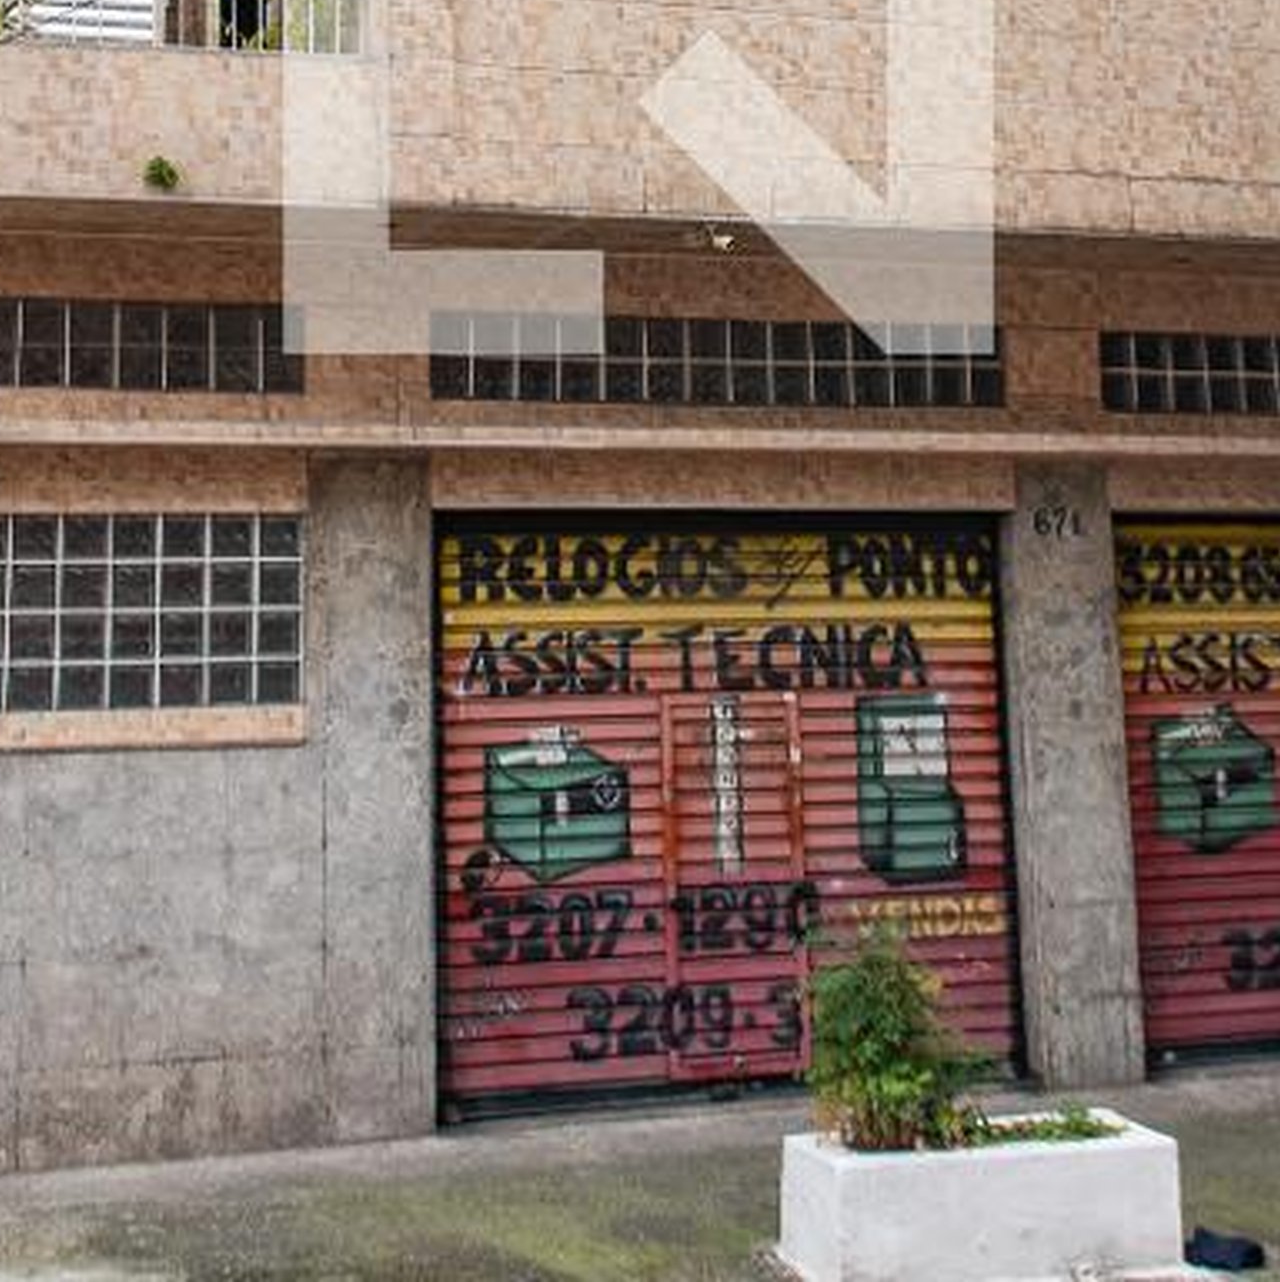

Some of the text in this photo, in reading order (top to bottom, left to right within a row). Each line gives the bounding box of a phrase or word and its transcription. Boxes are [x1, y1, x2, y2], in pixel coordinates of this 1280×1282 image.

[1033, 506, 1081, 542] 671
[458, 533, 749, 602] RELOGIOS
[826, 534, 993, 599] PONTO
[658, 621, 928, 692] TECNICA
